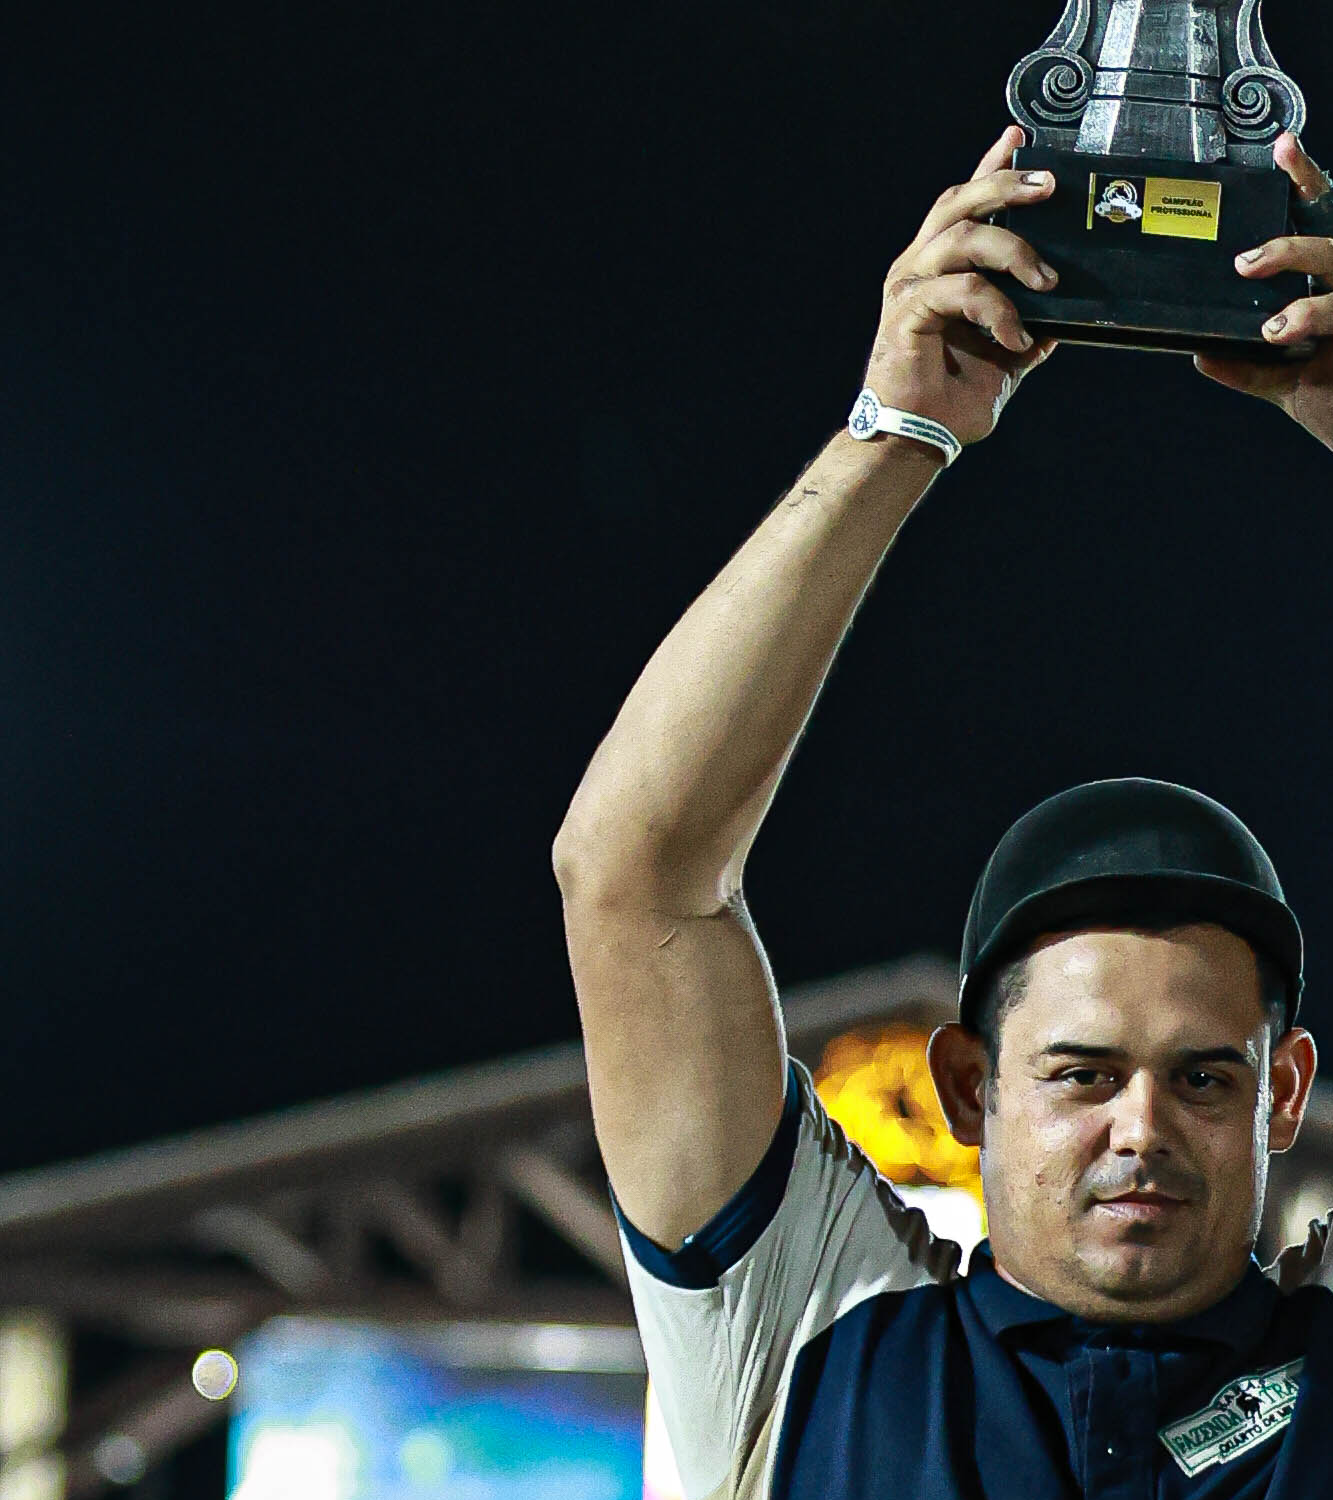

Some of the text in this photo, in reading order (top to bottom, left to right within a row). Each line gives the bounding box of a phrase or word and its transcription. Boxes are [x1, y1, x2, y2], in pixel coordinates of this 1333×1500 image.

[1172, 1410, 1244, 1454] FAZENDA
[1219, 1425, 1263, 1456] QUARTO
[1263, 1413, 1279, 1428] DE
